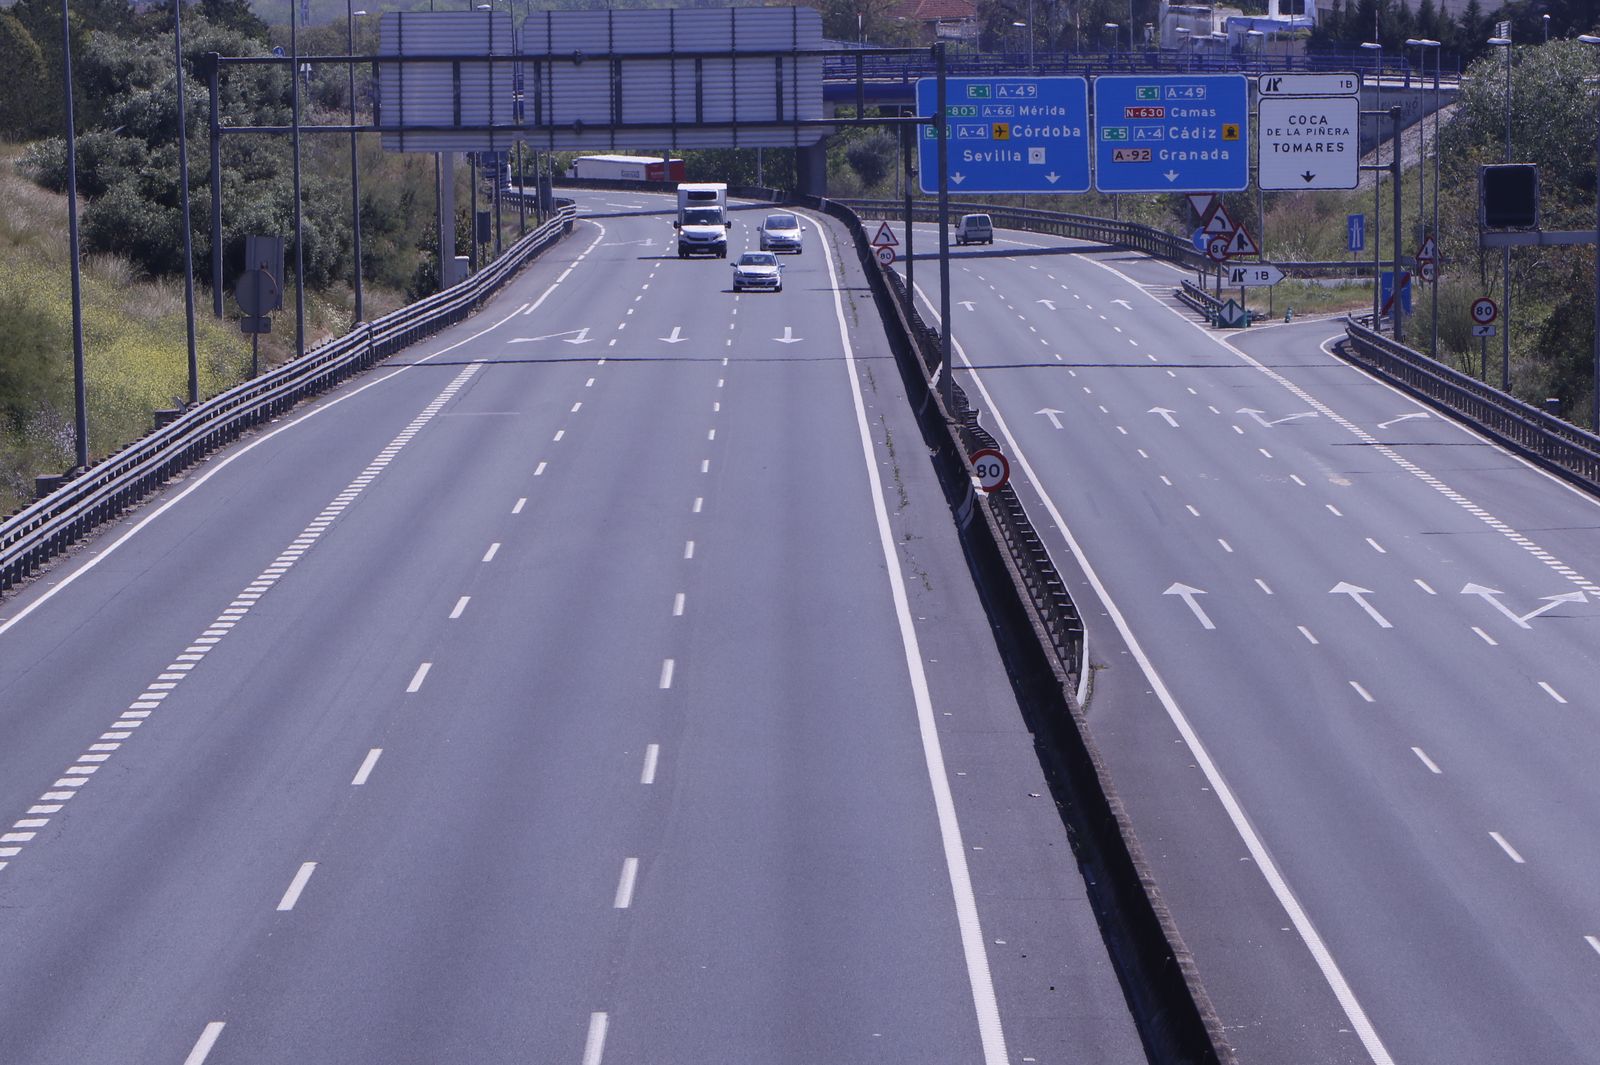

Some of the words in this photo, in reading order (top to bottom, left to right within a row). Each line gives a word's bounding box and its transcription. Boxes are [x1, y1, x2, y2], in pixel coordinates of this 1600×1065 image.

[968, 86, 990, 96] E-1
[998, 86, 1036, 96] A-49
[1138, 88, 1158, 98] E-1
[1168, 88, 1204, 98] A-49
[947, 106, 976, 116] -803
[984, 106, 1013, 116] A-66
[1020, 105, 1066, 116] Mérida
[1126, 108, 1163, 117] N-630
[1171, 108, 1216, 118] Camas
[1288, 115, 1328, 125] COCA
[960, 126, 986, 137] A-4
[1012, 124, 1080, 137] Córdoba
[1104, 129, 1126, 138] E-5
[1136, 129, 1162, 138] A-4
[1169, 126, 1216, 139] Cádiz
[1306, 127, 1350, 136] PIÑERA
[1273, 142, 1344, 152] TOMARES
[963, 150, 1021, 162] Sevilla
[1115, 150, 1150, 160] A-92
[1159, 149, 1230, 160] Granada
[1255, 272, 1269, 280] 1B
[1476, 306, 1492, 316] 80
[977, 464, 1000, 478] 80
